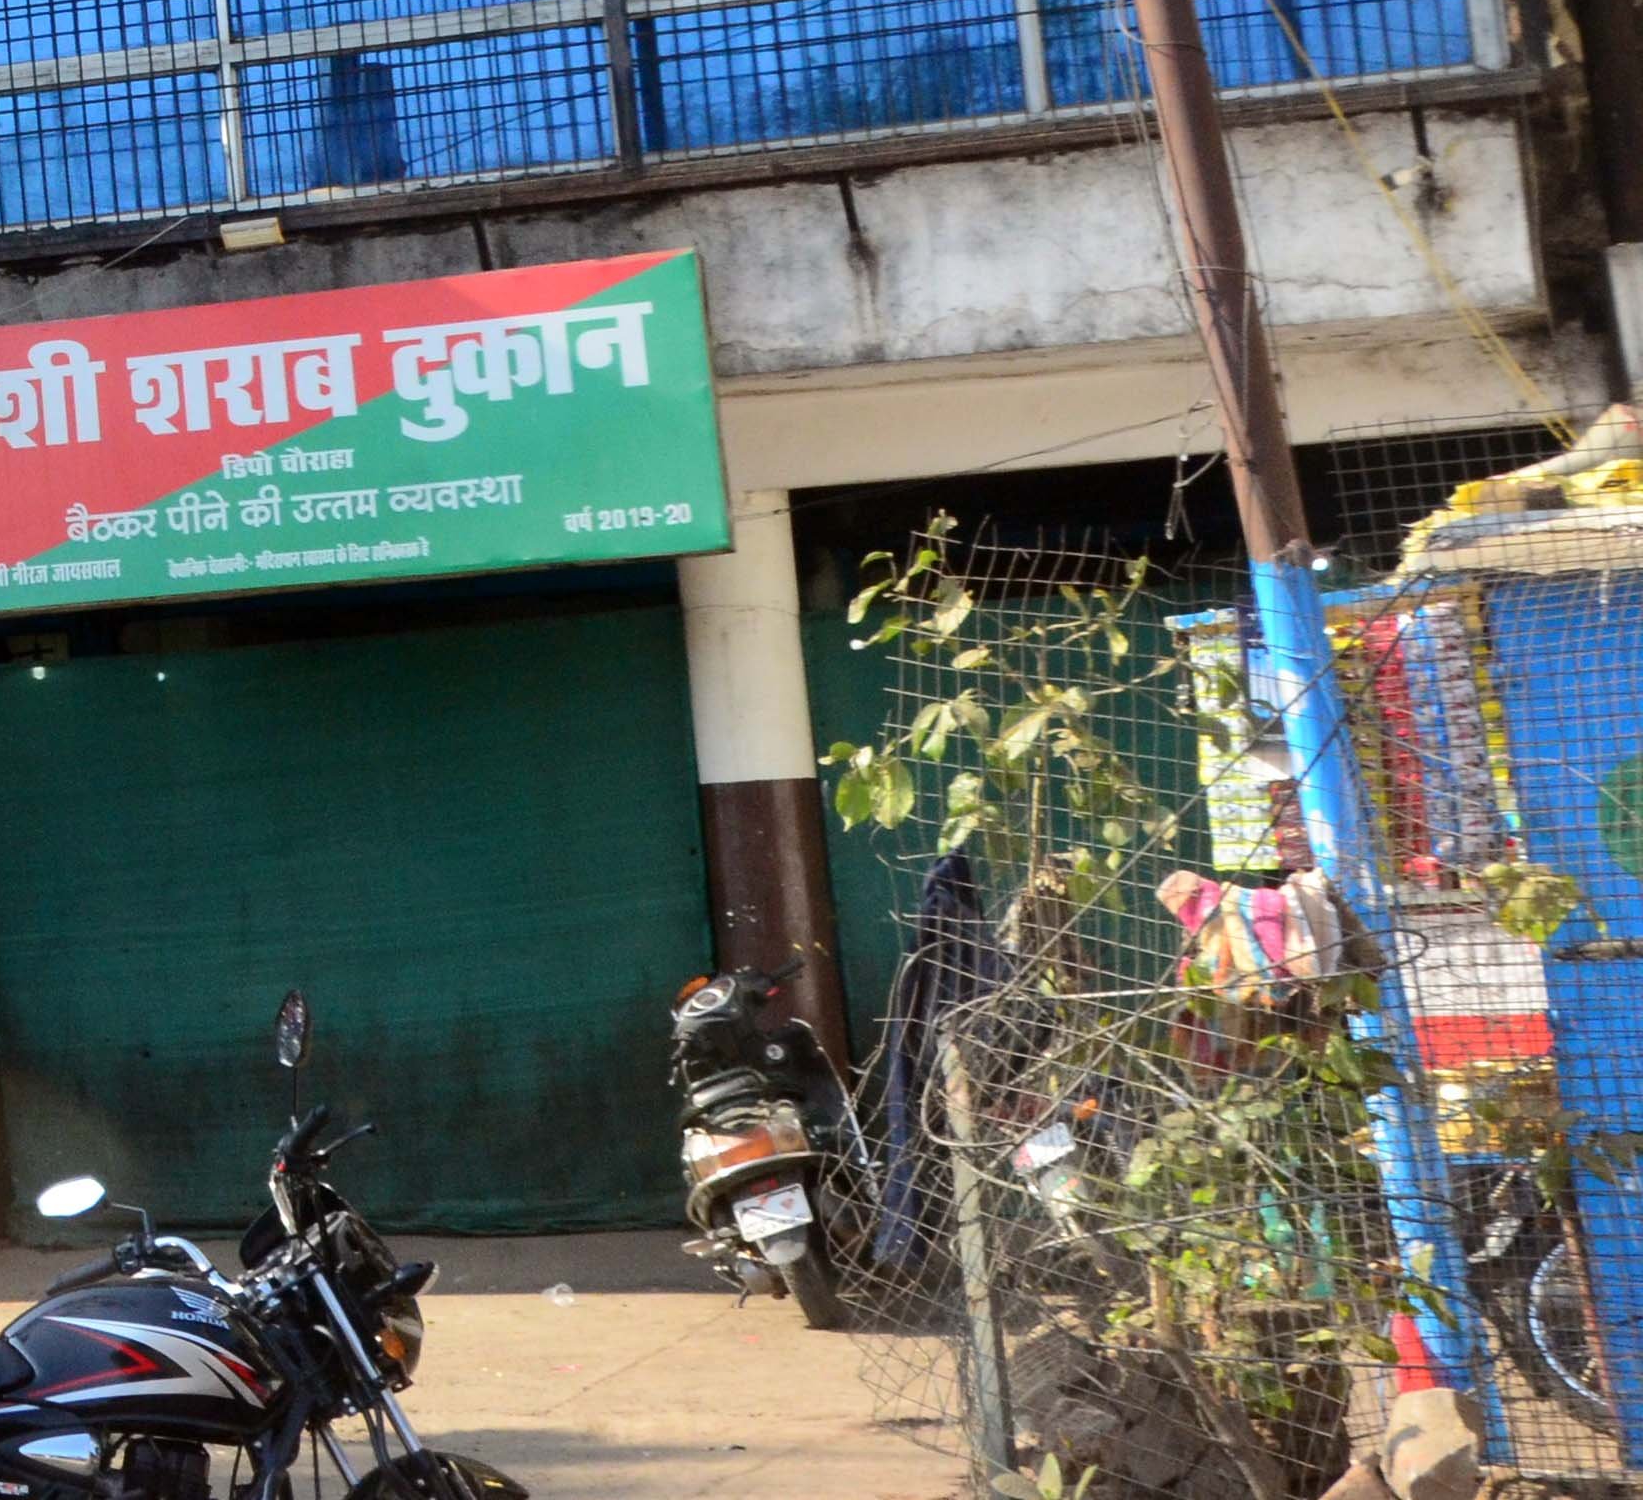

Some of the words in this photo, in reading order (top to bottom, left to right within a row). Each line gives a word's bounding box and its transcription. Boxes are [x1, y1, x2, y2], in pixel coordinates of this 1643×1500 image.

[127, 333, 360, 435] शराब
[383, 300, 653, 443] दुकान
[221, 452, 274, 479] डिपो
[280, 446, 354, 474] चौराहा
[65, 503, 156, 543] बैठकर
[167, 490, 229, 535] पीने
[240, 484, 282, 527] की
[292, 488, 379, 524] उत्तम
[388, 474, 522, 514] व्यवस्था
[564, 506, 593, 532] वर्ष
[598, 503, 692, 530] 2019-20
[12, 561, 48, 584] नीरज
[51, 559, 121, 582] जायसवाल
[171, 1311, 231, 1330] HONDA
